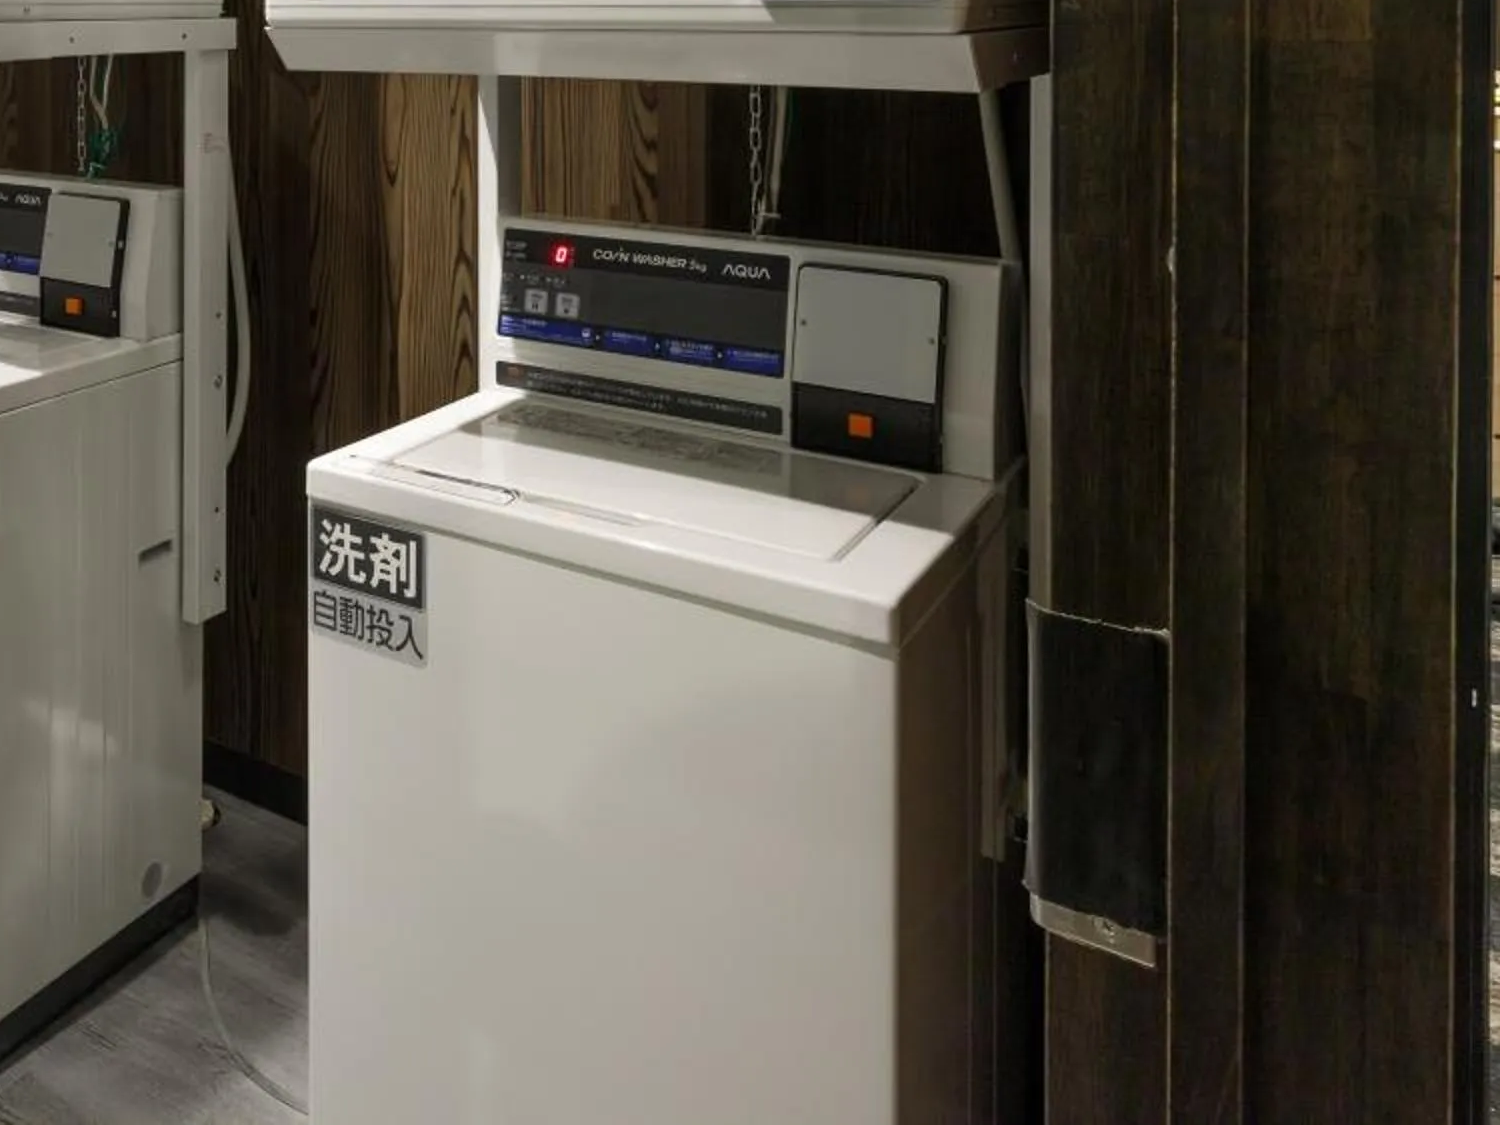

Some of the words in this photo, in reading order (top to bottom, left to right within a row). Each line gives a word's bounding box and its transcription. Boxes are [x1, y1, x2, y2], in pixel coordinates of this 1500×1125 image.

[555, 247, 568, 263] 0
[632, 252, 686, 269] WASHER
[721, 263, 771, 281] AQUA
[320, 519, 417, 598] 洗剤
[313, 590, 424, 660] 自動投入
